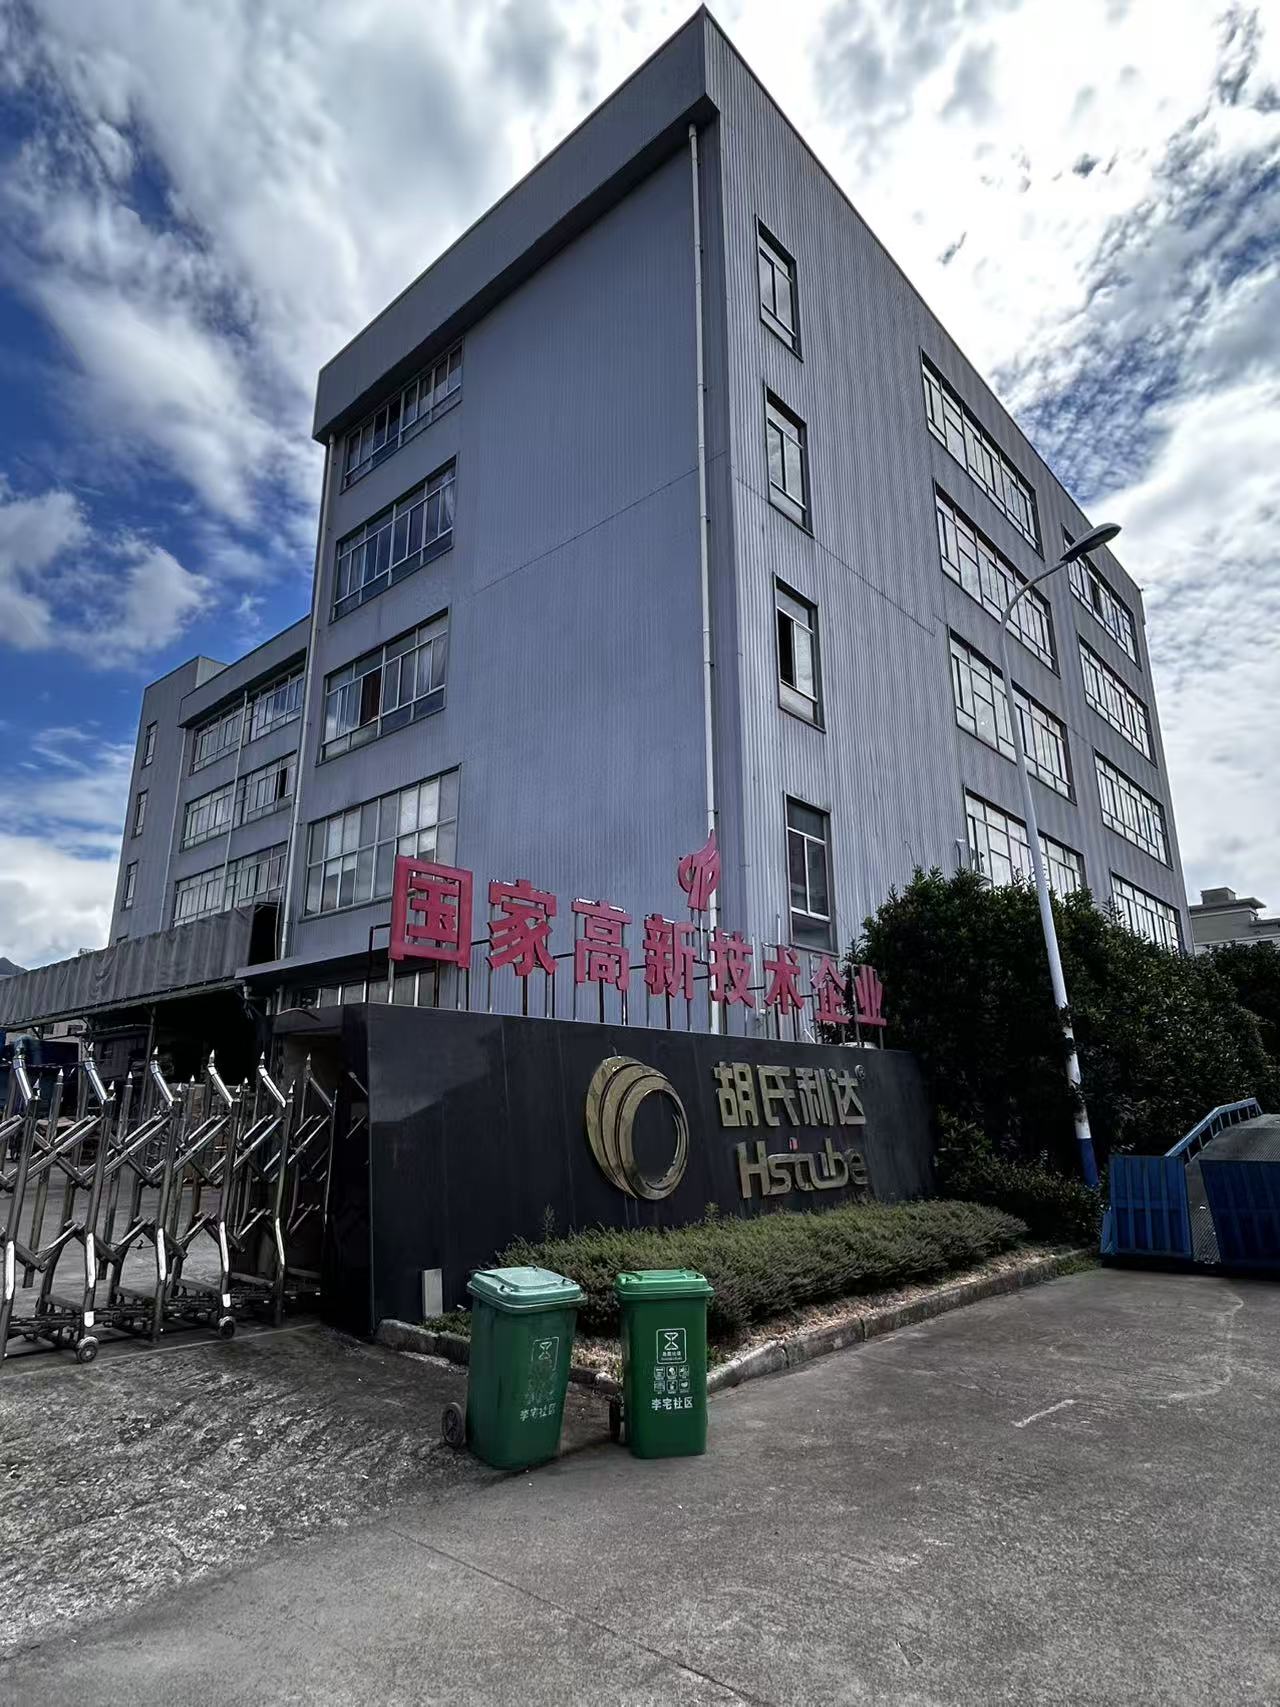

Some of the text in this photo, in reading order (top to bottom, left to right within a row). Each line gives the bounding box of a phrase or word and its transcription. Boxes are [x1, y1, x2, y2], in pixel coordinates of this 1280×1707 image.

[389, 855, 886, 1027] 国家高新技术企业
[714, 1061, 866, 1126] 胡氏利达
[736, 1137, 869, 1199] Hstube
[651, 1396, 693, 1411] 李宅社区
